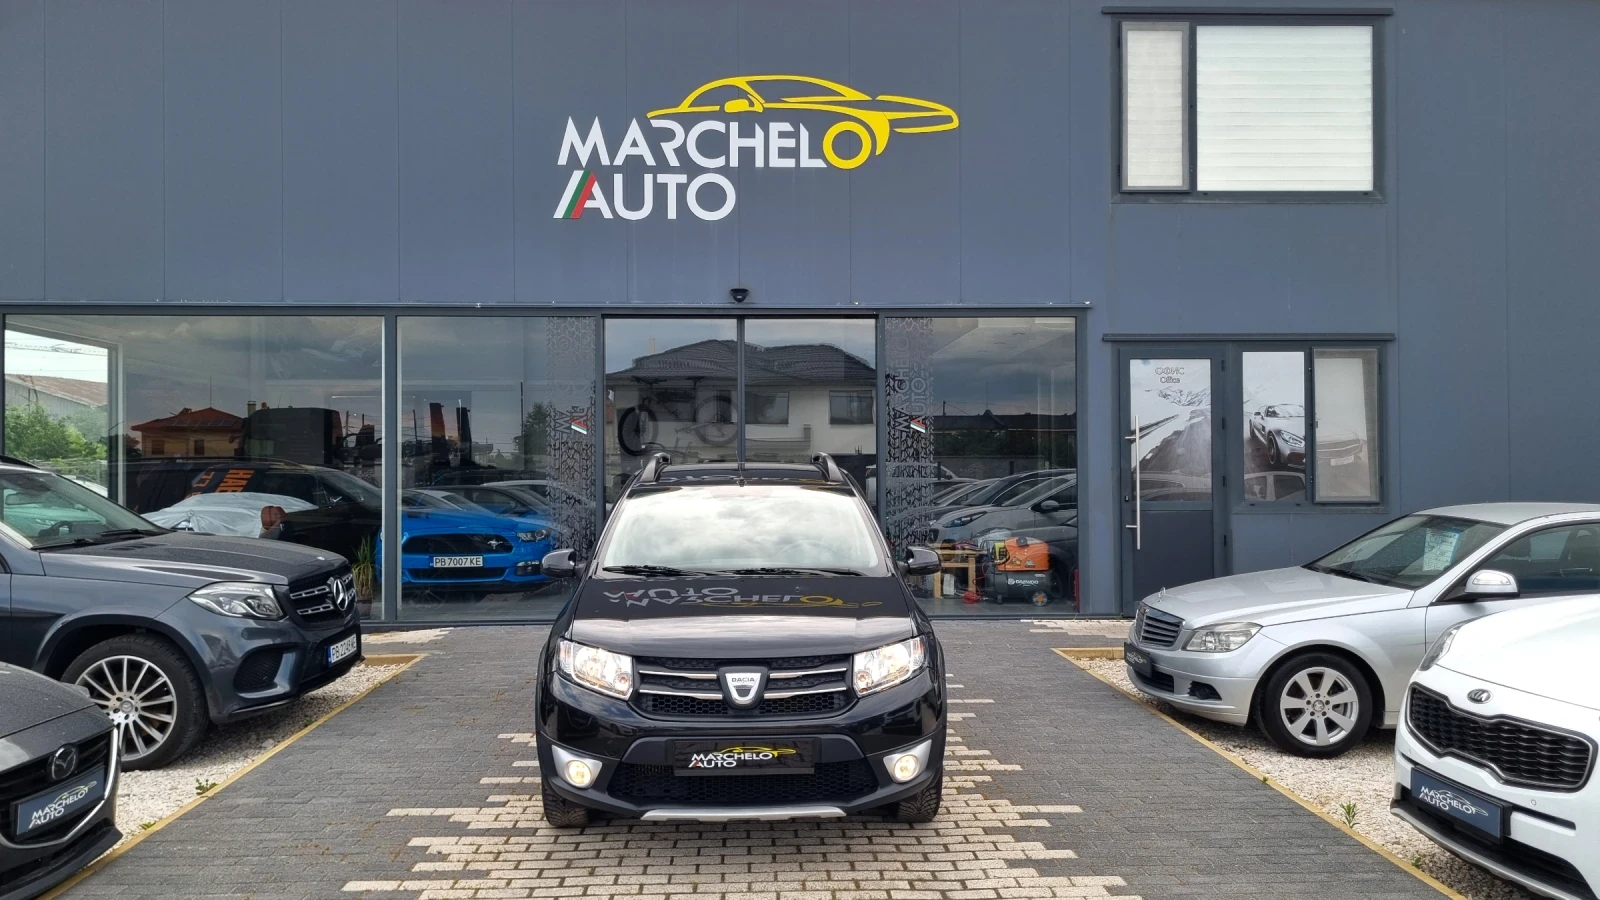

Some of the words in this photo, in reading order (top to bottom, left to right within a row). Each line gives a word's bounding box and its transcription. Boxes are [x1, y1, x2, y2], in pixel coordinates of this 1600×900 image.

[557, 115, 872, 170] MARCHELO
[552, 169, 737, 221] AUTO
[688, 760, 737, 768] AUTO
[691, 752, 773, 761] MARCHELO
[31, 790, 86, 820] MARCHELO
[1419, 792, 1449, 811] AUTO
[1420, 786, 1473, 814] MARCHELO
[28, 807, 65, 829] AUTO
